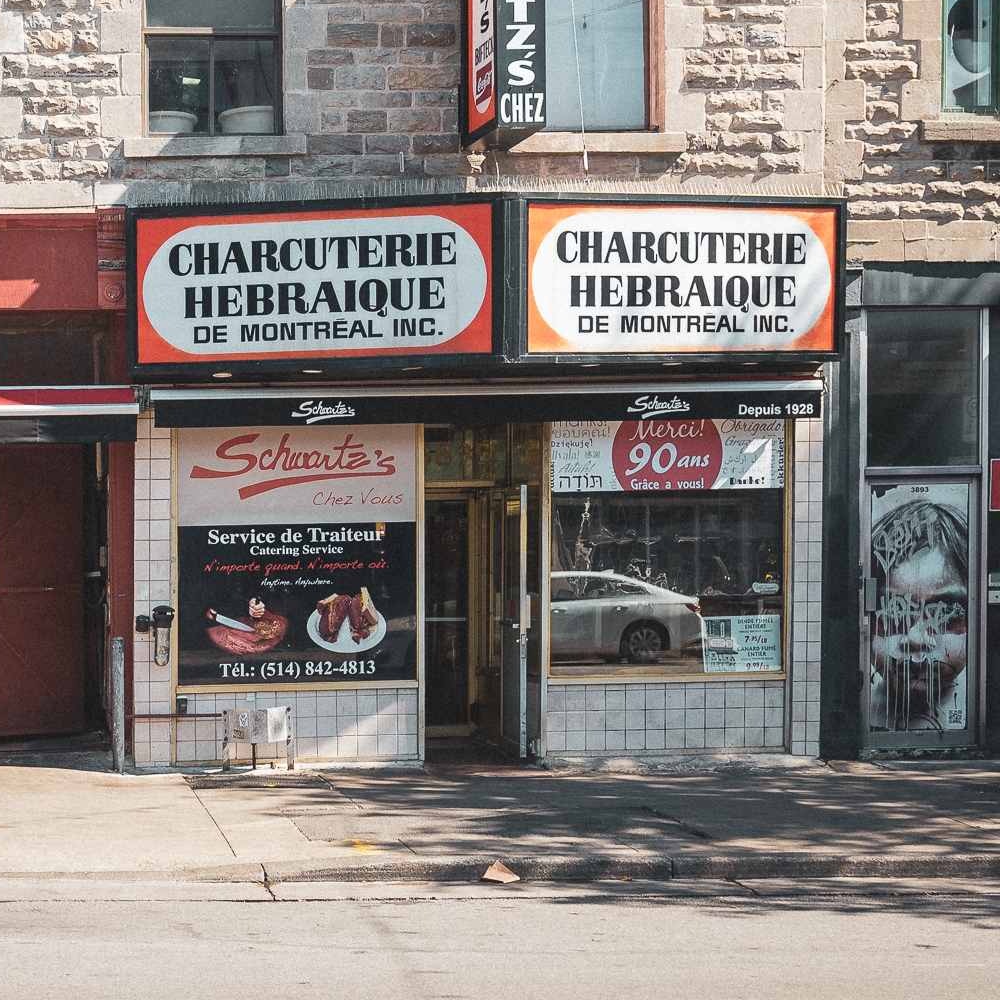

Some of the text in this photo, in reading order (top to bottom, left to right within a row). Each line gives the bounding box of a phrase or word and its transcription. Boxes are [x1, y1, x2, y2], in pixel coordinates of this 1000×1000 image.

[500, 92, 544, 123] CHEZ
[168, 232, 457, 277] CHARCUTERIE
[556, 230, 806, 265] CHARCUTERIE
[184, 276, 445, 318] HEBRAIQUE
[569, 275, 796, 313] HEBRAIQUE
[193, 318, 443, 344] DE MONTRÉAL INC.
[578, 313, 794, 334] DE MONTRÉAL INC.
[291, 400, 355, 424] Schwartz's
[627, 395, 690, 419] Schwartz's
[738, 403, 814, 417] Depuis 1928
[628, 420, 705, 440] Merci!
[551, 438, 593, 448] Dziękuję!
[190, 433, 396, 500] Schwartz's
[625, 442, 678, 476] 90
[677, 454, 709, 468] ans
[630, 477, 704, 490] Grâce a vous!
[730, 476, 765, 485] Danke!
[313, 488, 404, 506] Chez Vous
[207, 527, 384, 545] Service de Traiteur
[250, 544, 343, 556] Catering Service
[204, 557, 390, 576] N'importe quand. N'importe où.
[261, 577, 334, 587] Anytime. Anywhere.
[219, 660, 376, 680] Tél.: (514) 842-4813
